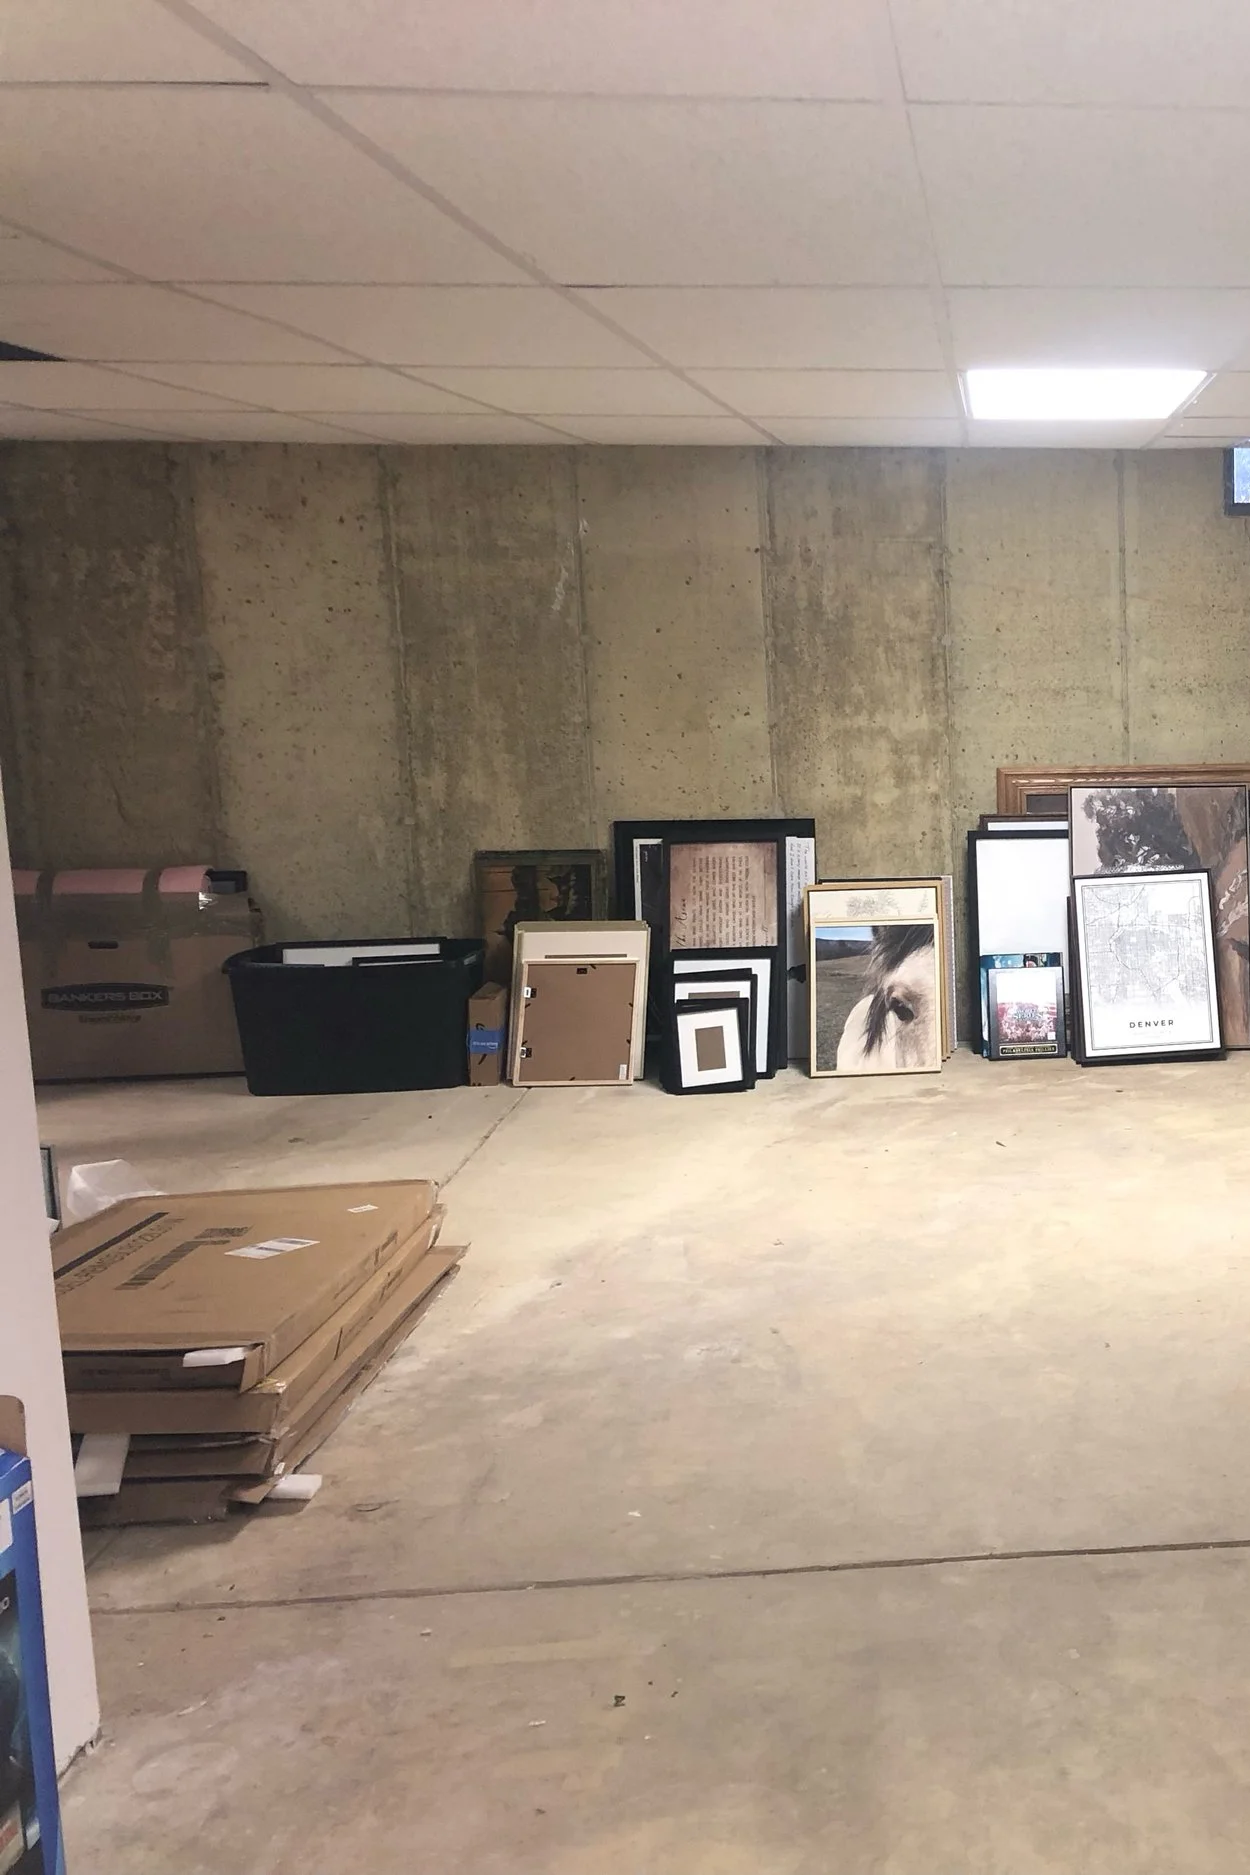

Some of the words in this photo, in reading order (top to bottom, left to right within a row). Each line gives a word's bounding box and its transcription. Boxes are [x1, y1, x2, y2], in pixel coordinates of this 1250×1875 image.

[48, 991, 126, 1004] BANKERS
[129, 991, 164, 1002] BOX
[1129, 1019, 1174, 1029] DENVER
